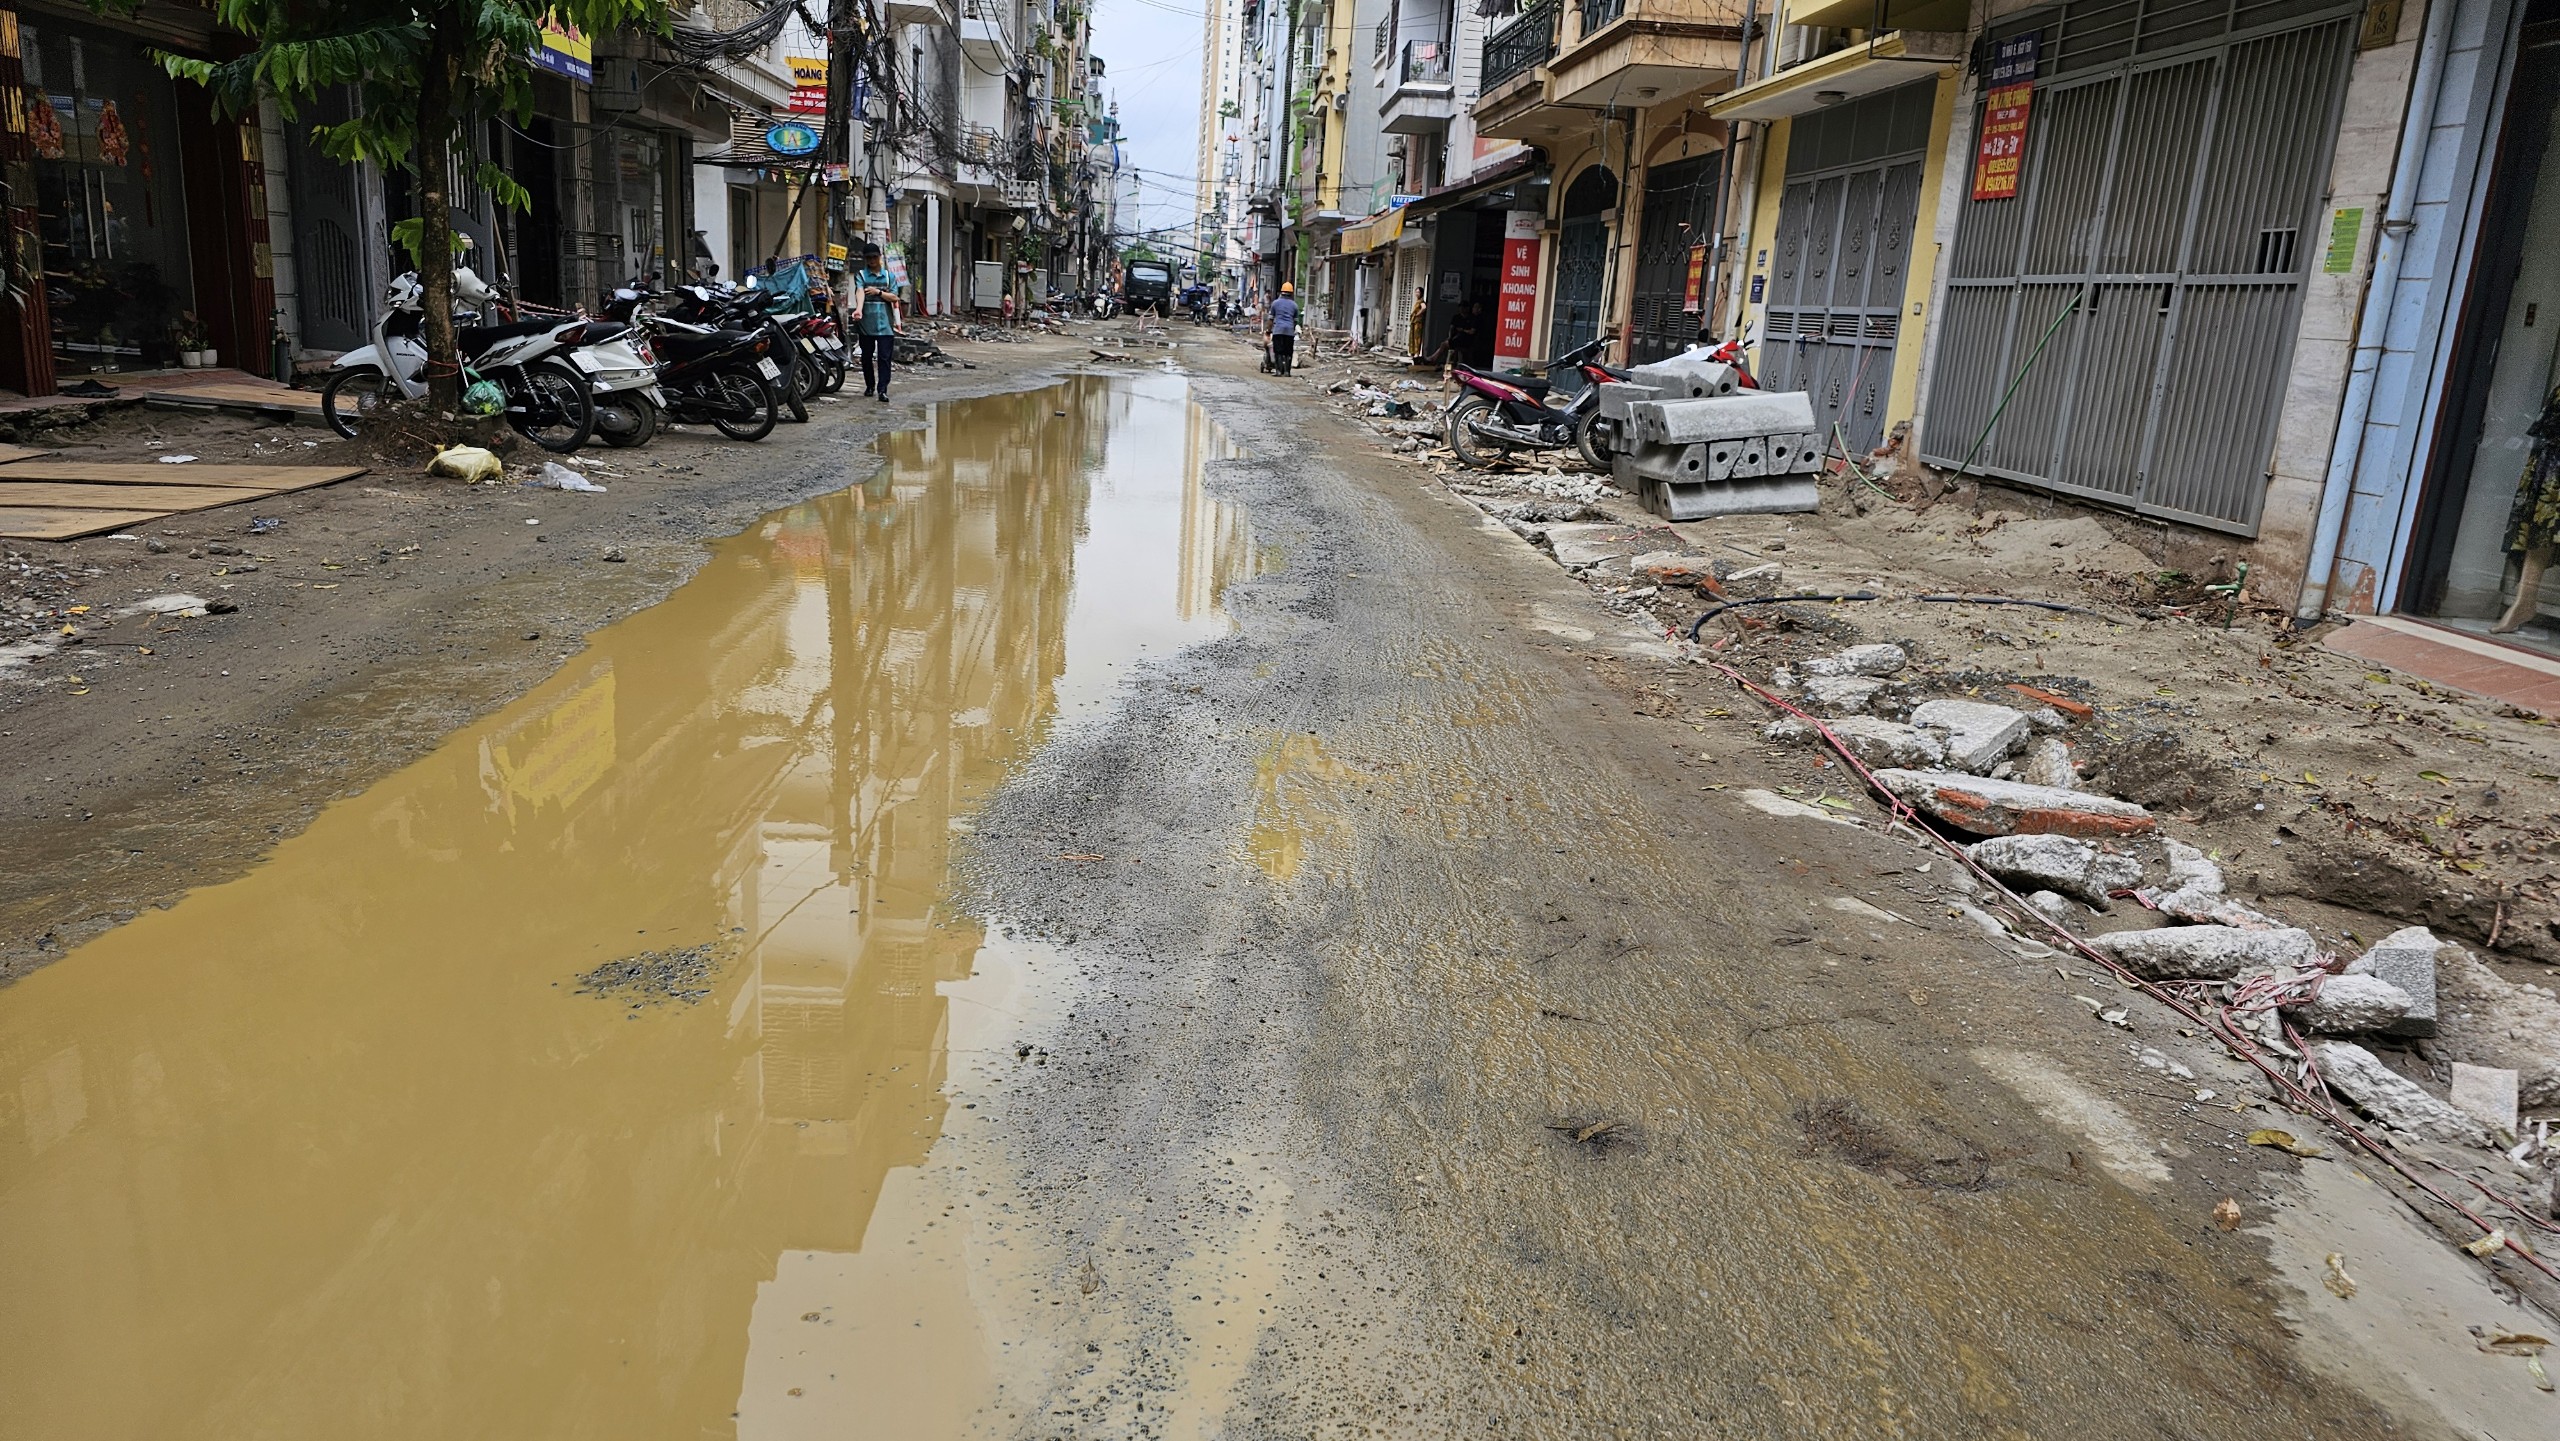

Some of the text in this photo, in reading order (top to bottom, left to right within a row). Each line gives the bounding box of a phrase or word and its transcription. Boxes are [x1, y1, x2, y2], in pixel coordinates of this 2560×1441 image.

[2379, 3, 2389, 22] 6
[794, 65, 822, 80] HOÀNG
[1516, 245, 1528, 261] VỆ
[1511, 265, 1530, 277] SINH
[1502, 283, 1535, 296] KHOANG
[1507, 298, 1527, 312] MÁY
[1504, 318, 1526, 330] THAY
